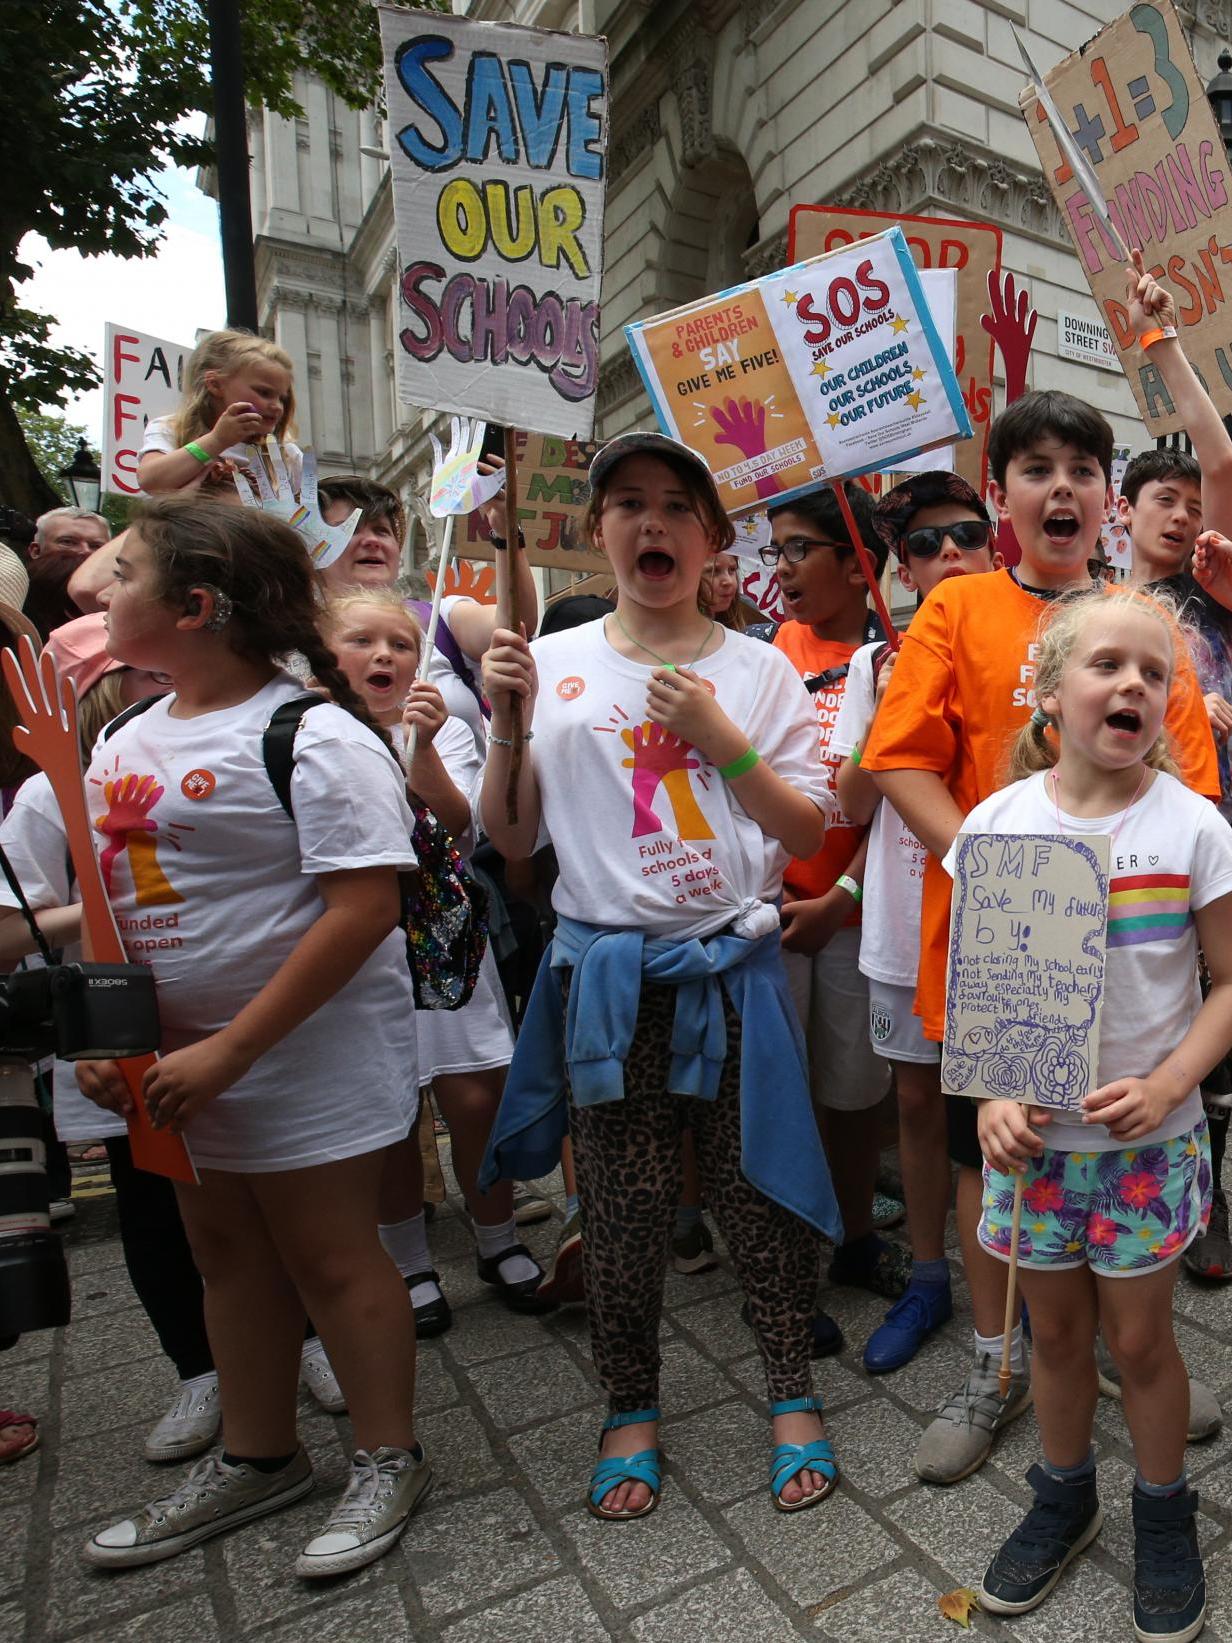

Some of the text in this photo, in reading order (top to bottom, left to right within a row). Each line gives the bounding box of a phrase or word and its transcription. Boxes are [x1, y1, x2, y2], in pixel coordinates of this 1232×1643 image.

[394, 34, 606, 181] SAVE
[1065, 140, 1229, 276] FUNDING
[437, 178, 590, 280] OUR
[795, 259, 891, 348] SOS
[400, 259, 601, 402] SCHOOLS
[672, 316, 759, 358] & CHILDREN
[675, 304, 743, 339] PARENTS
[811, 308, 895, 361] SAVE OUR SCHOOLS
[1065, 317, 1108, 339] DOWNING
[699, 338, 741, 371] SAY
[1065, 331, 1099, 350] STREET
[677, 349, 780, 396] GIVE ME FIVE!
[820, 341, 909, 396] OUR CHILDREN
[828, 360, 913, 412] OUR SCHOOLS
[840, 403, 867, 427] OUR
[867, 380, 915, 414] FUTURE
[717, 470, 730, 481] NO
[770, 455, 801, 473] SCHOOLS
[812, 467, 827, 480] SOS
[638, 840, 673, 858] Fully
[641, 852, 700, 877] schools
[671, 866, 719, 887] 5 days
[675, 879, 722, 904] a wek
[968, 884, 1020, 913] Save
[133, 935, 183, 953] open
